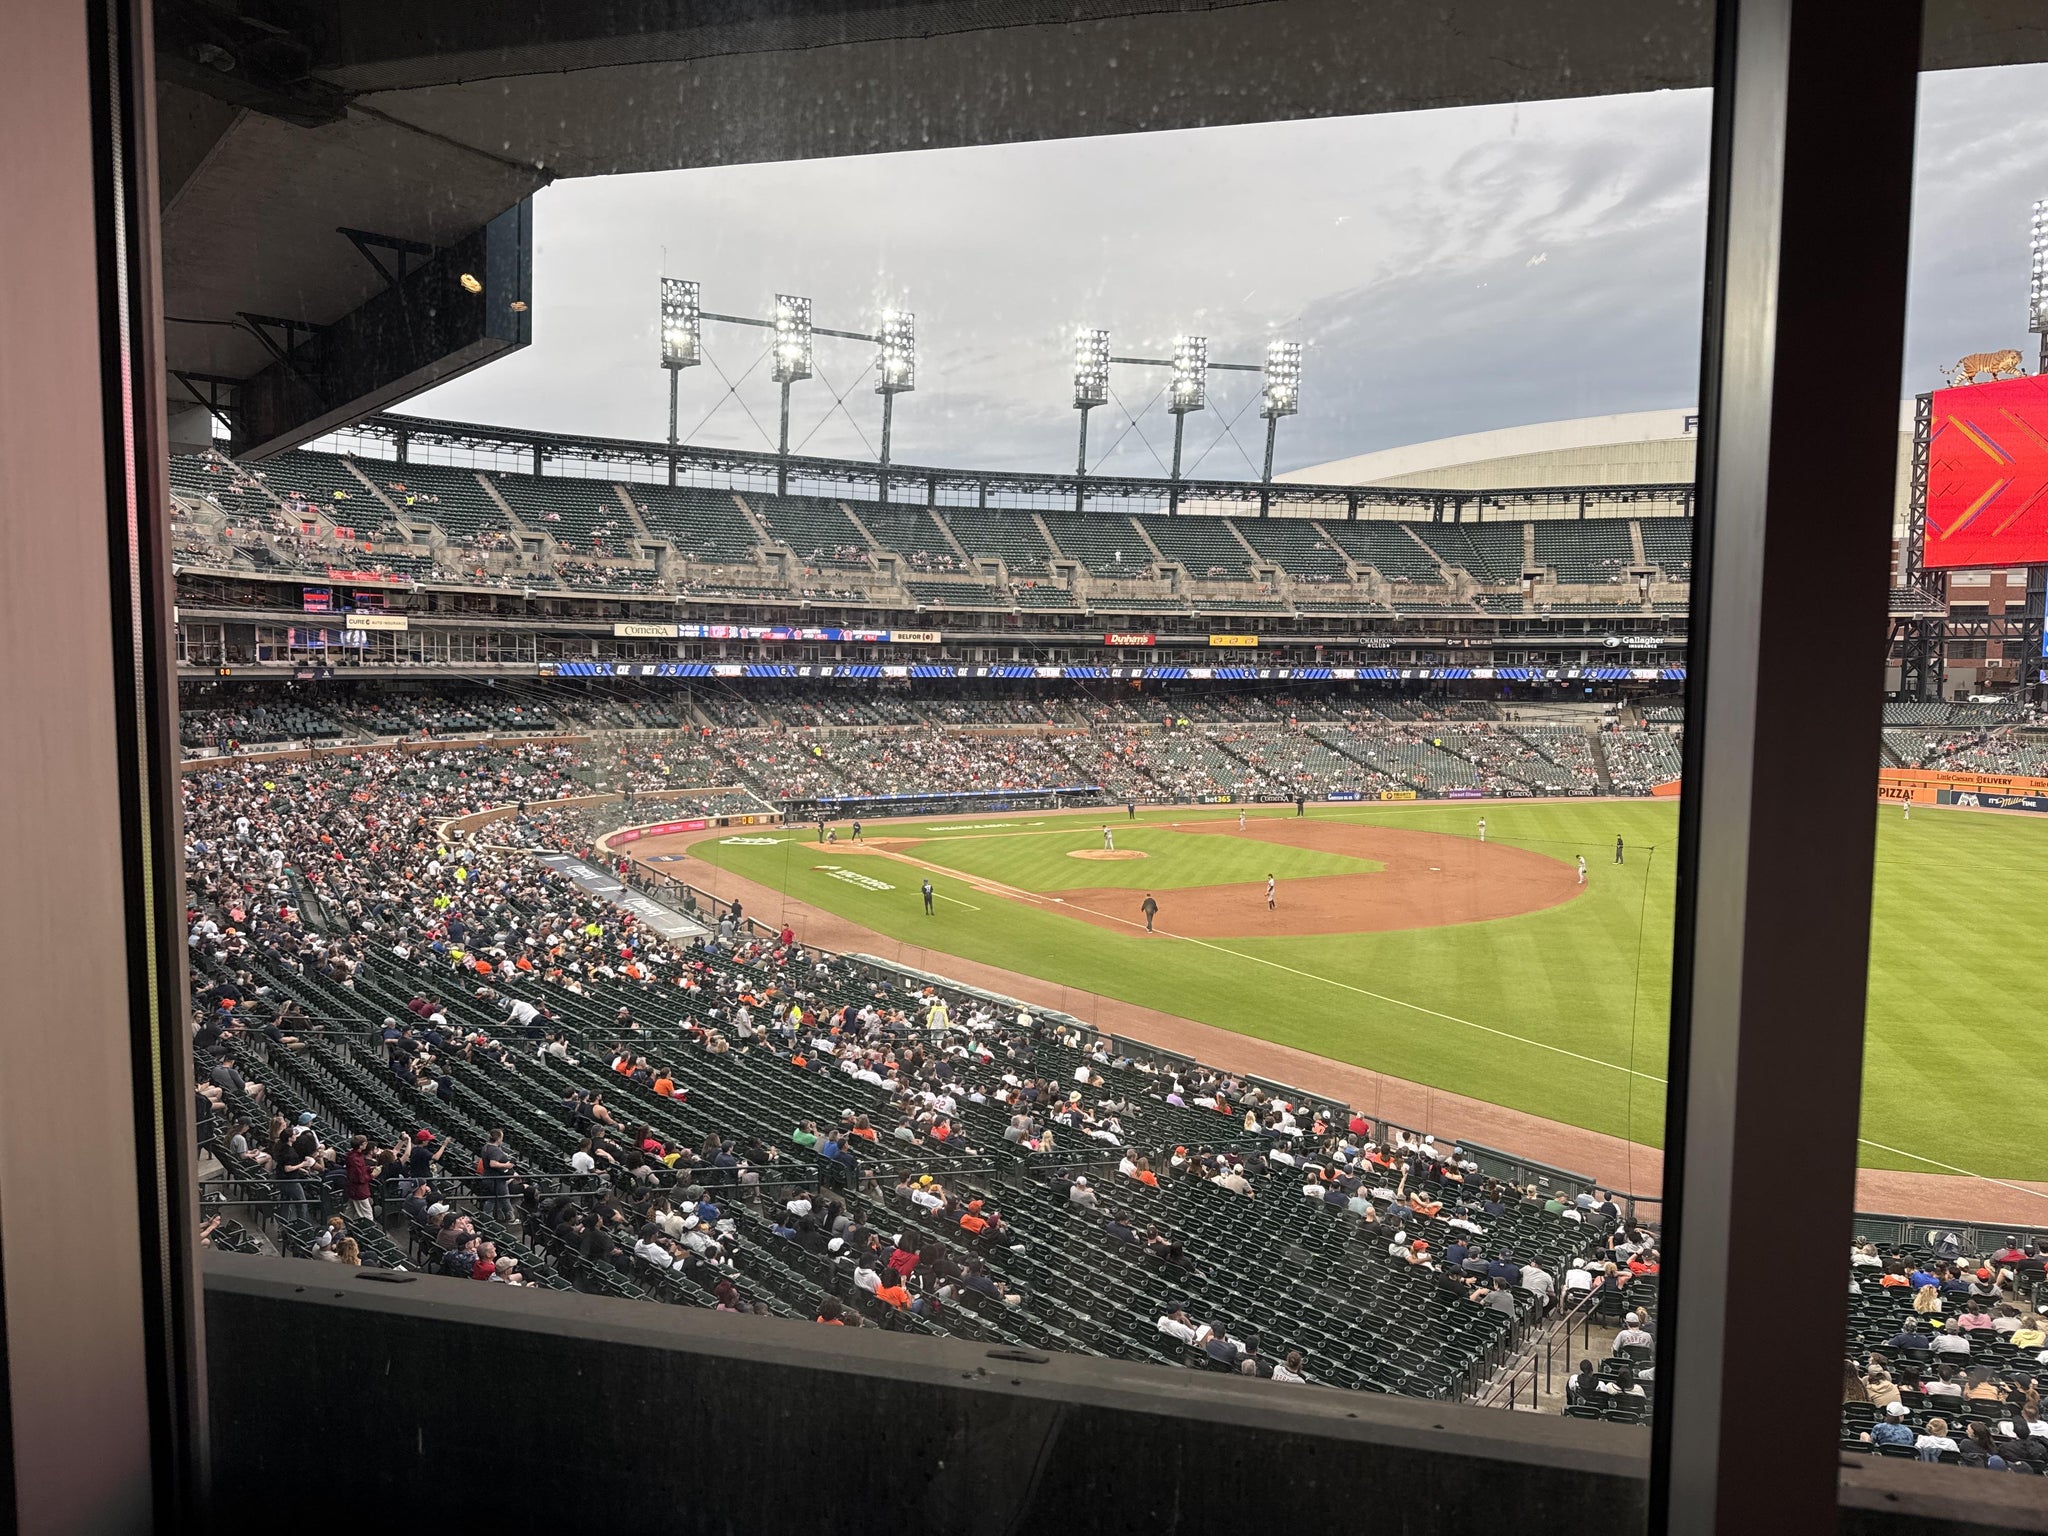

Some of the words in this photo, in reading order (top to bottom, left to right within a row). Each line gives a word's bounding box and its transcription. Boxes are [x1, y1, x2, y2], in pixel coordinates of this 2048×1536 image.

[1111, 634, 1149, 643] Dunham's
[1359, 637, 1397, 645] CHAMPIONS
[1622, 636, 1665, 645] Gallagher
[1936, 773, 1952, 781] Little
[1951, 774, 1974, 783] Caesars
[1975, 775, 2013, 785] DELIVERY
[2030, 780, 2046, 788] Little
[1879, 787, 1914, 800] PIZZA!
[1204, 795, 1231, 803] bet365
[2022, 800, 2038, 808] TIME
